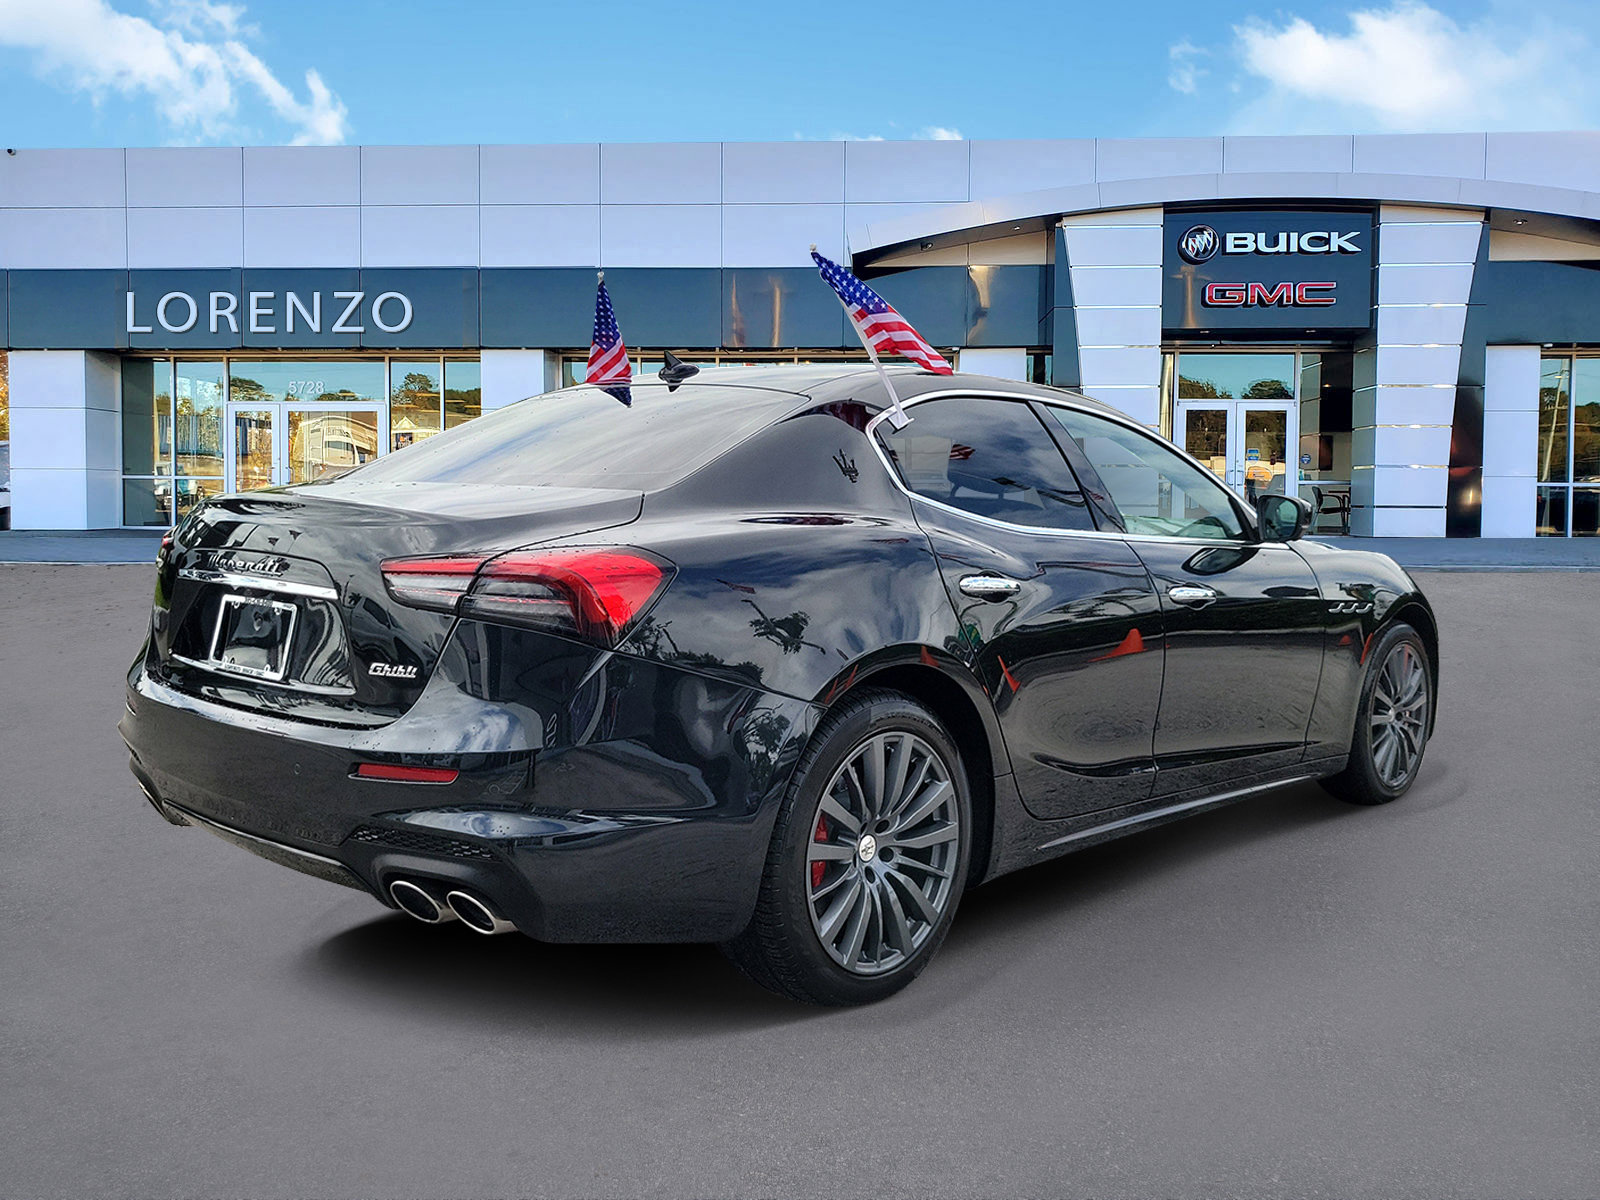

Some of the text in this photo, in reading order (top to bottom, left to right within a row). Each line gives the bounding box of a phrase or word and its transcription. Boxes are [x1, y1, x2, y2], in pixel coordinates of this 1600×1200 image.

[1225, 231, 1362, 253] BUICK
[1205, 282, 1337, 305] GMC
[125, 290, 414, 334] LORENZO
[288, 380, 325, 395] 5728
[207, 551, 284, 577] Maserati
[368, 661, 418, 679] Ghibli
